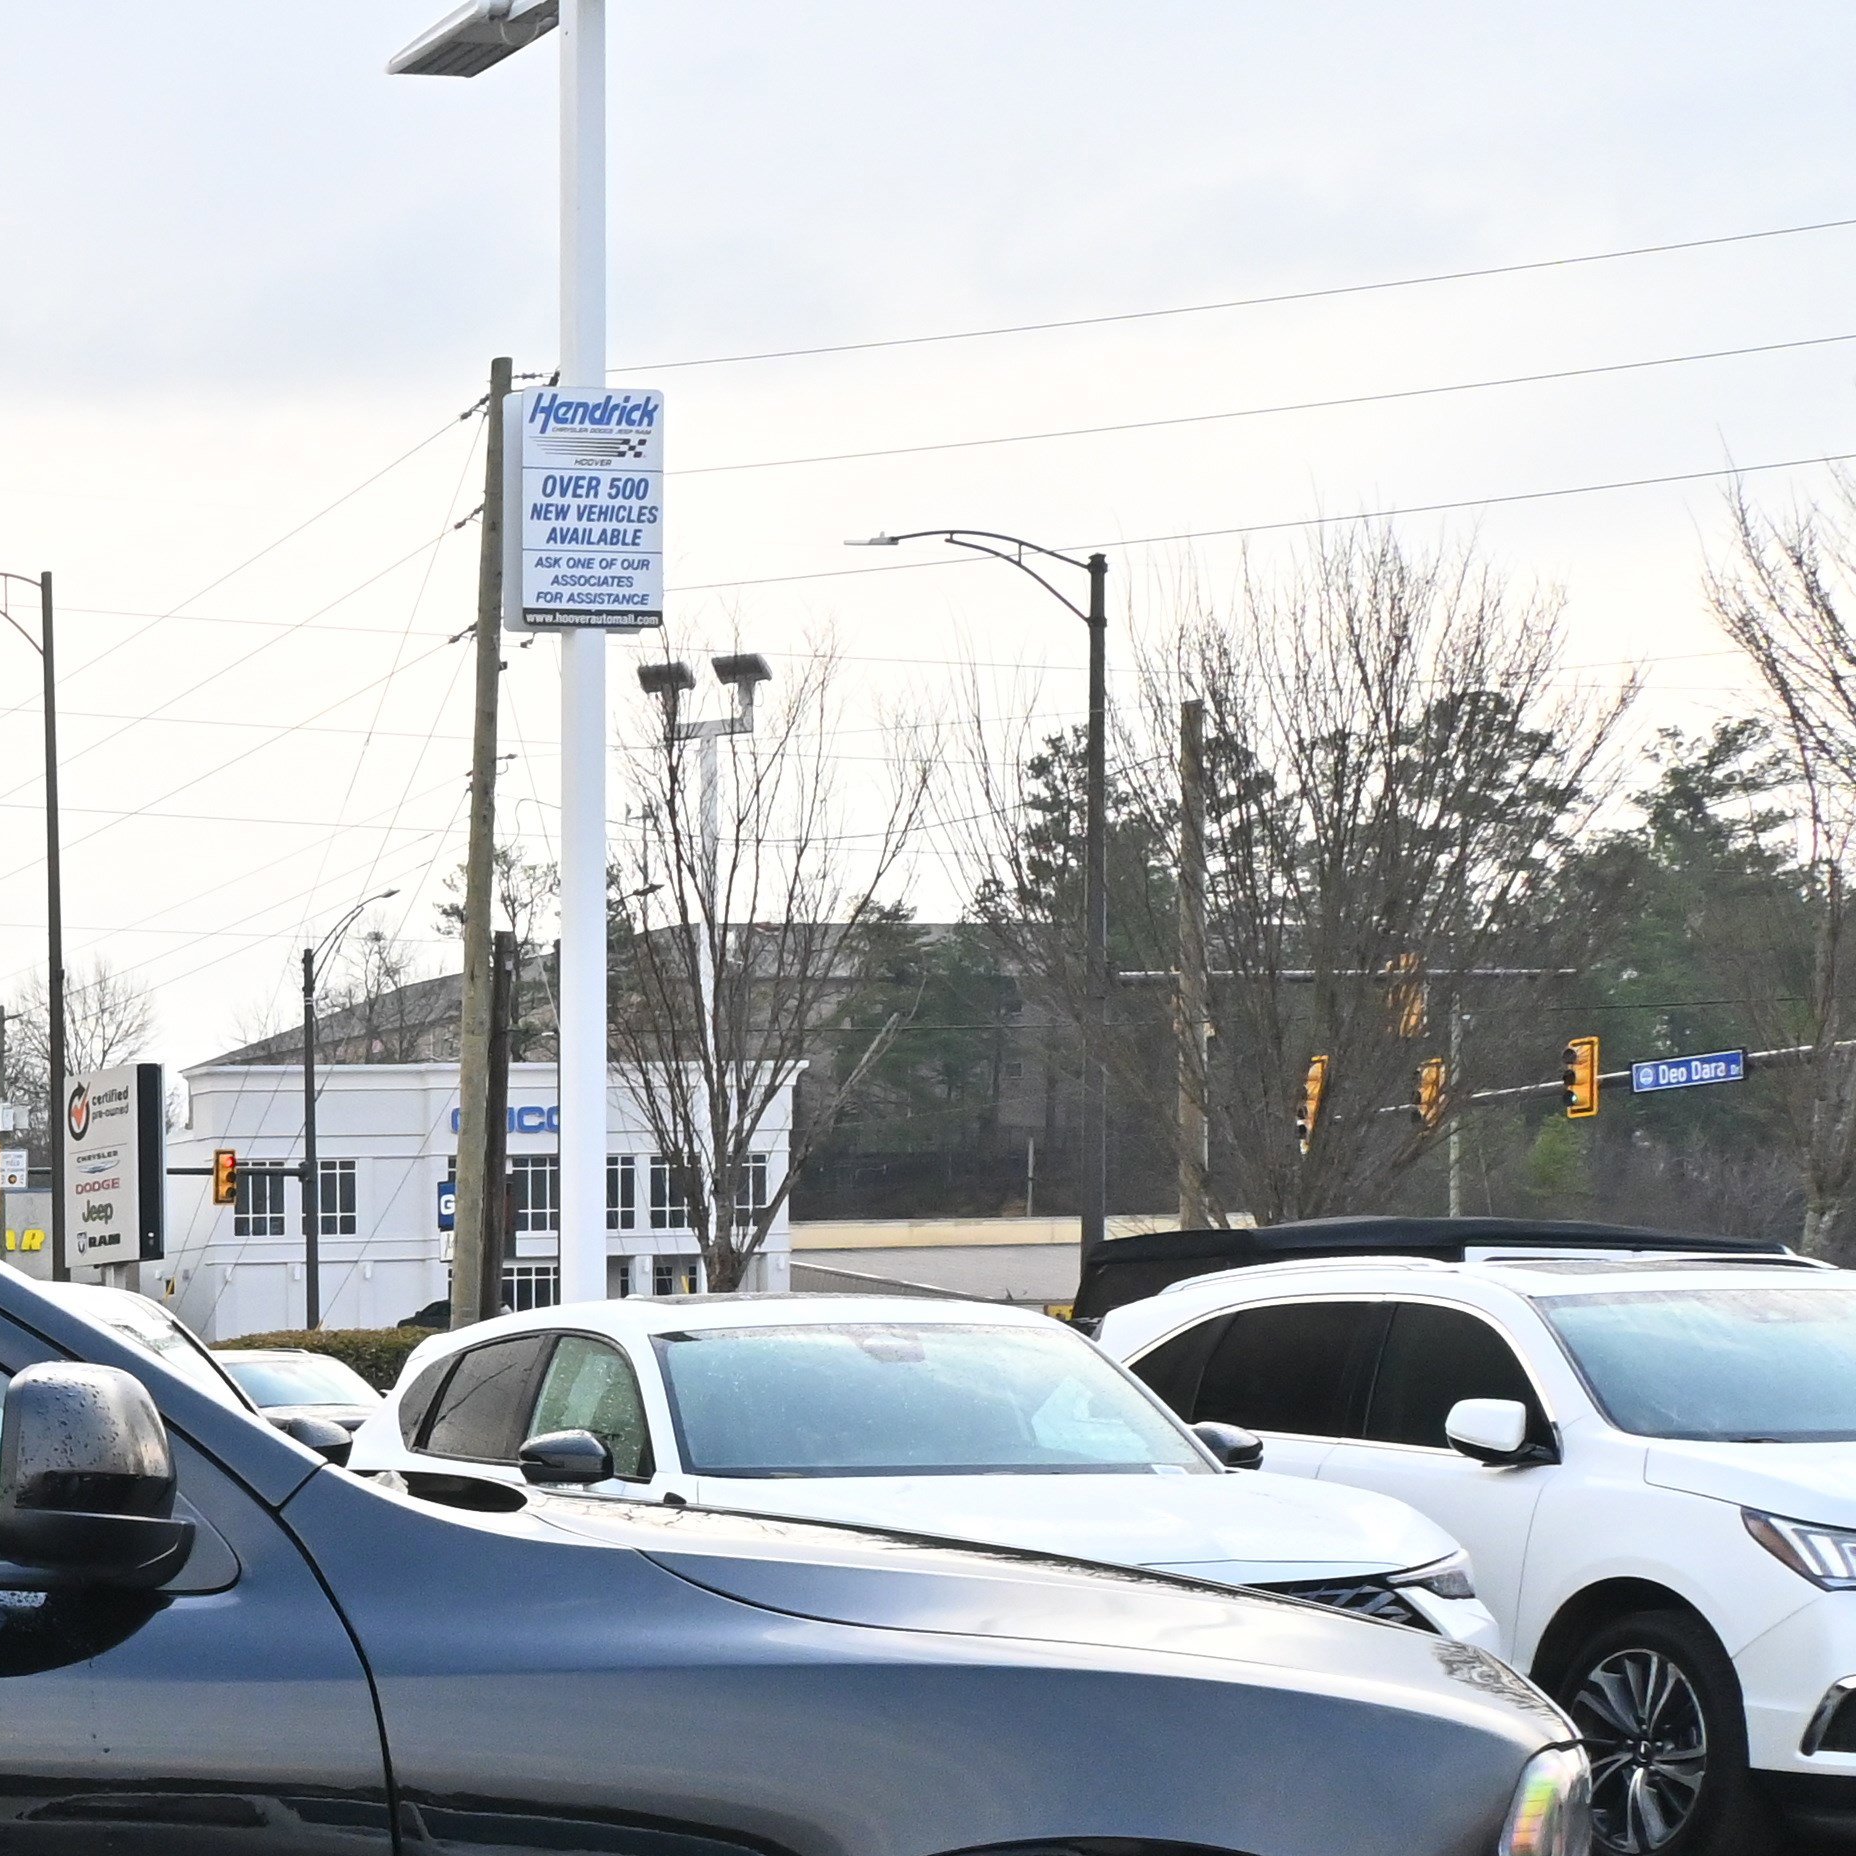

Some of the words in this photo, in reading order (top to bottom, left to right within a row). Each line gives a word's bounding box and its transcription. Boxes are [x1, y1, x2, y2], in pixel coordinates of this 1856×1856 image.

[528, 392, 659, 434] Hendrick
[541, 474, 601, 499] OVER
[607, 477, 649, 501] 500
[530, 502, 571, 521] NEW
[576, 504, 659, 524] VEHICLES
[546, 526, 643, 546] AVAILABLE
[534, 556, 562, 569] ASK
[565, 557, 596, 569] ONE
[598, 558, 618, 570] OF
[620, 558, 651, 571] OUR
[550, 574, 634, 588] ASSOCIATES
[535, 591, 564, 604] FOR
[566, 592, 650, 606] ASSISTANCE
[525, 611, 659, 625] www.hooverautomall.com
[1658, 1064, 1688, 1085] Deo
[1691, 1060, 1726, 1081] Dara
[91, 1085, 129, 1107] certified
[91, 1104, 129, 1124] pre-owned
[76, 1150, 119, 1164] CHRYSLER
[75, 1177, 120, 1195] DODGE
[82, 1200, 113, 1225] Jeep
[88, 1233, 121, 1248] RAM
